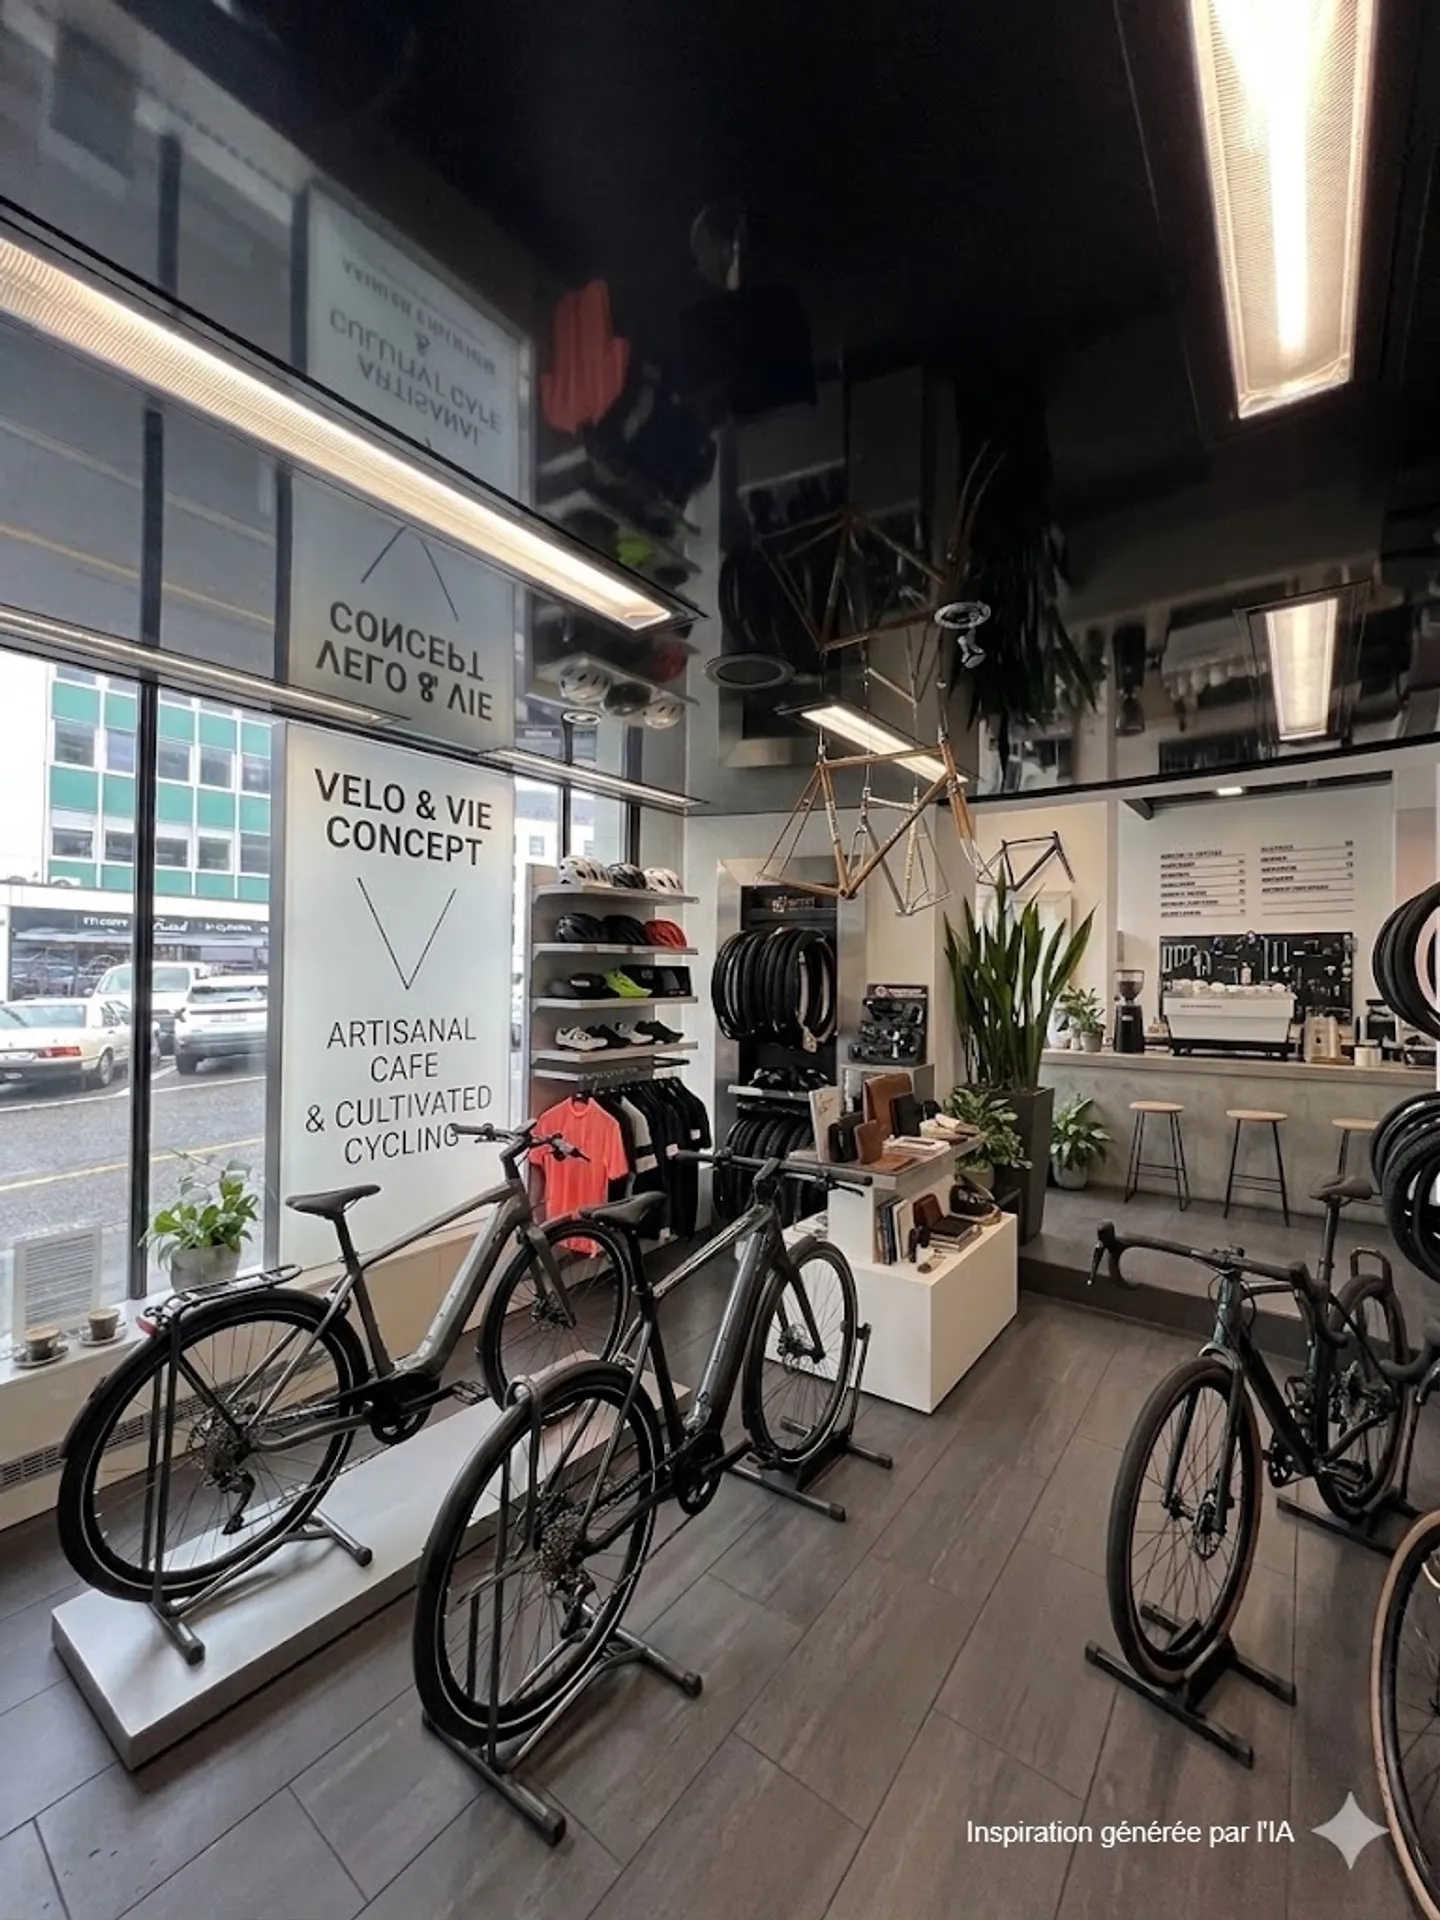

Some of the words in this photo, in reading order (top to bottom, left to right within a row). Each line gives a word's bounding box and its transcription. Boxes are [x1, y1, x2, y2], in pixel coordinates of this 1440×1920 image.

[314, 768, 405, 814] VELO
[416, 790, 436, 821] &
[446, 795, 493, 830] VIE
[326, 816, 483, 866] CONCEPT
[327, 1017, 477, 1049] ARTISANAL
[370, 1052, 438, 1083] CAFE
[305, 1104, 325, 1133] &
[335, 1085, 492, 1129] CULTIVATED
[344, 1123, 459, 1165] CYCLING
